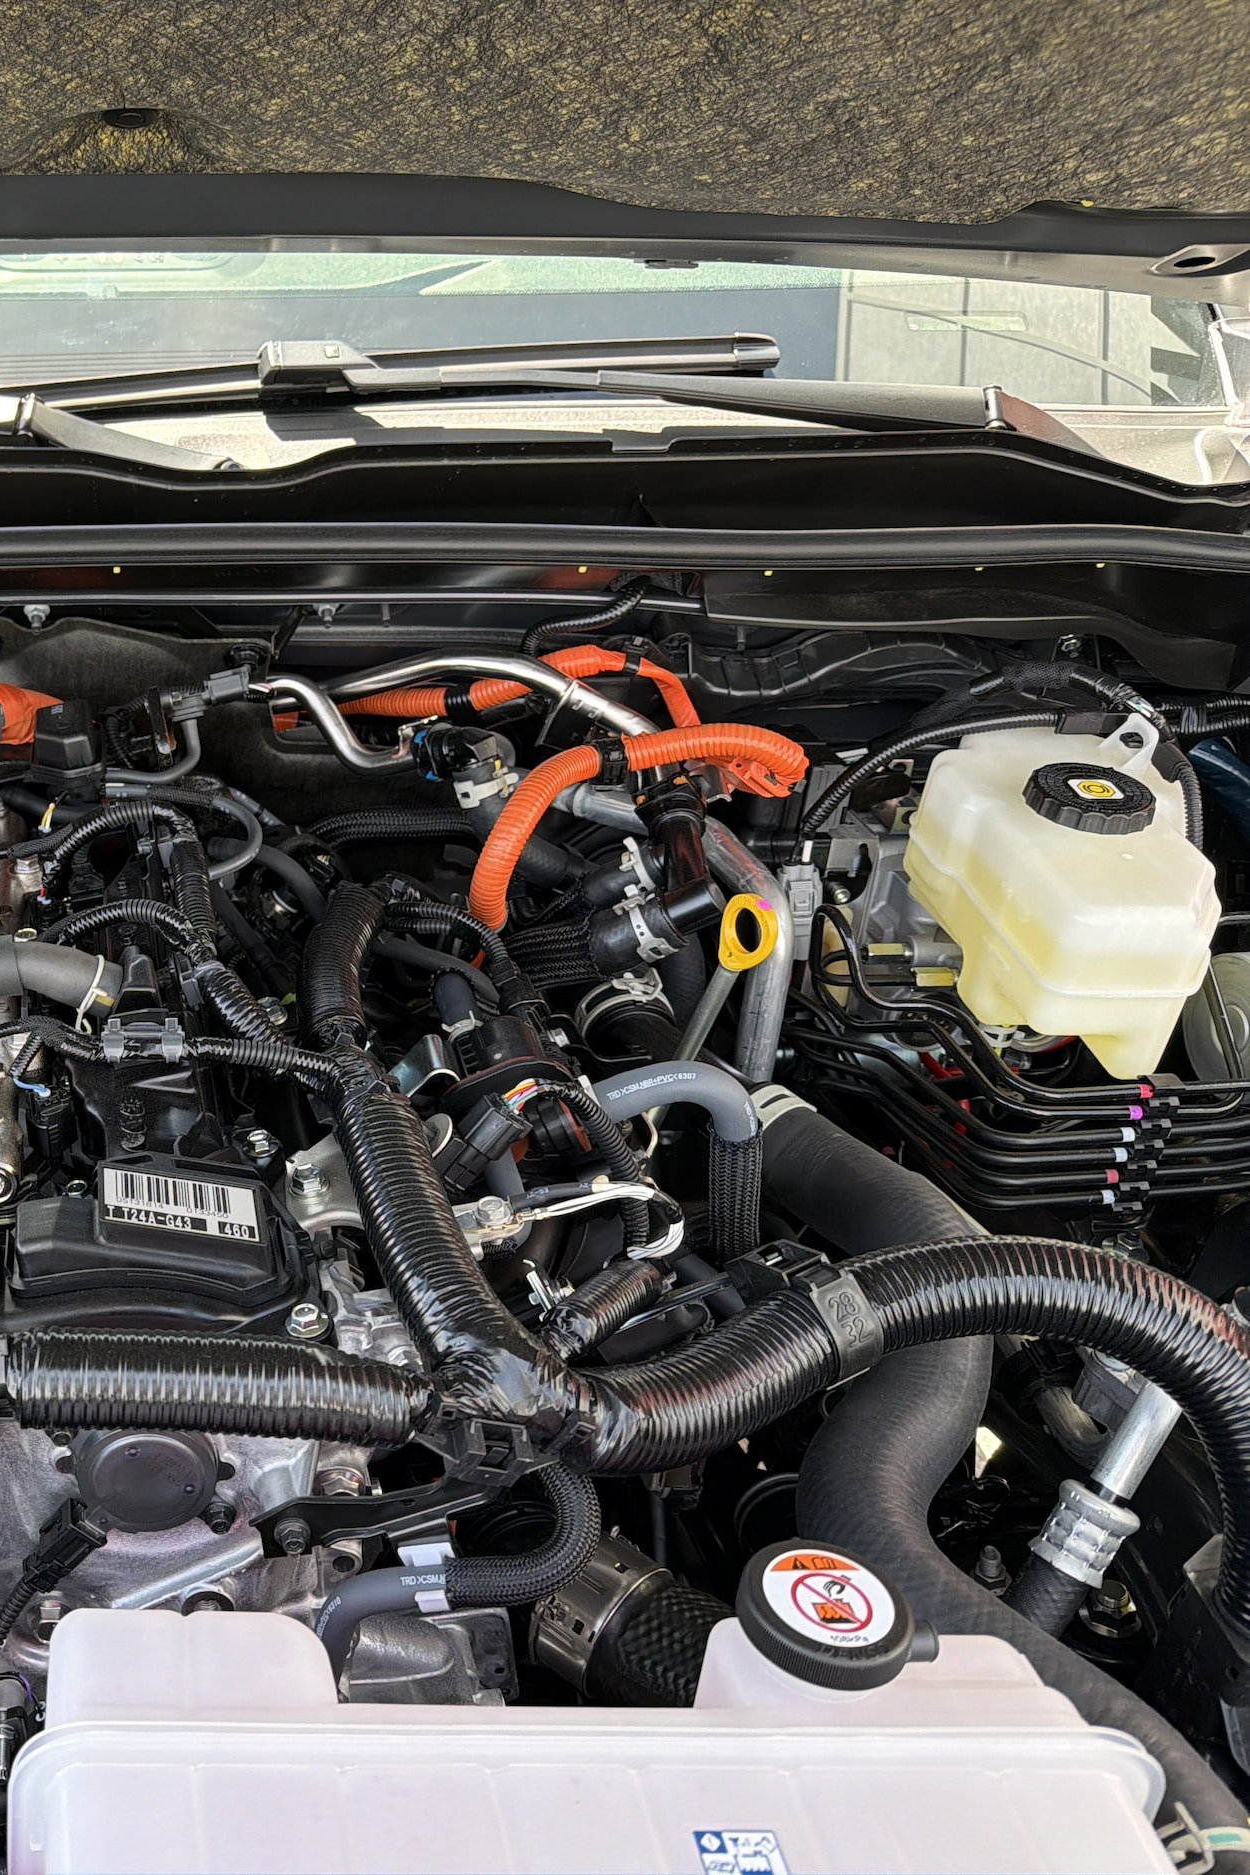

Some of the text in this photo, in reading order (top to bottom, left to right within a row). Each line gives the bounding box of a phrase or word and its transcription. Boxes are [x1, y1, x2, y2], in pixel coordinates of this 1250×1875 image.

[106, 1205, 250, 1239] T T24A-G43 460
[828, 1291, 859, 1323] 28
[841, 1315, 872, 1349] 32
